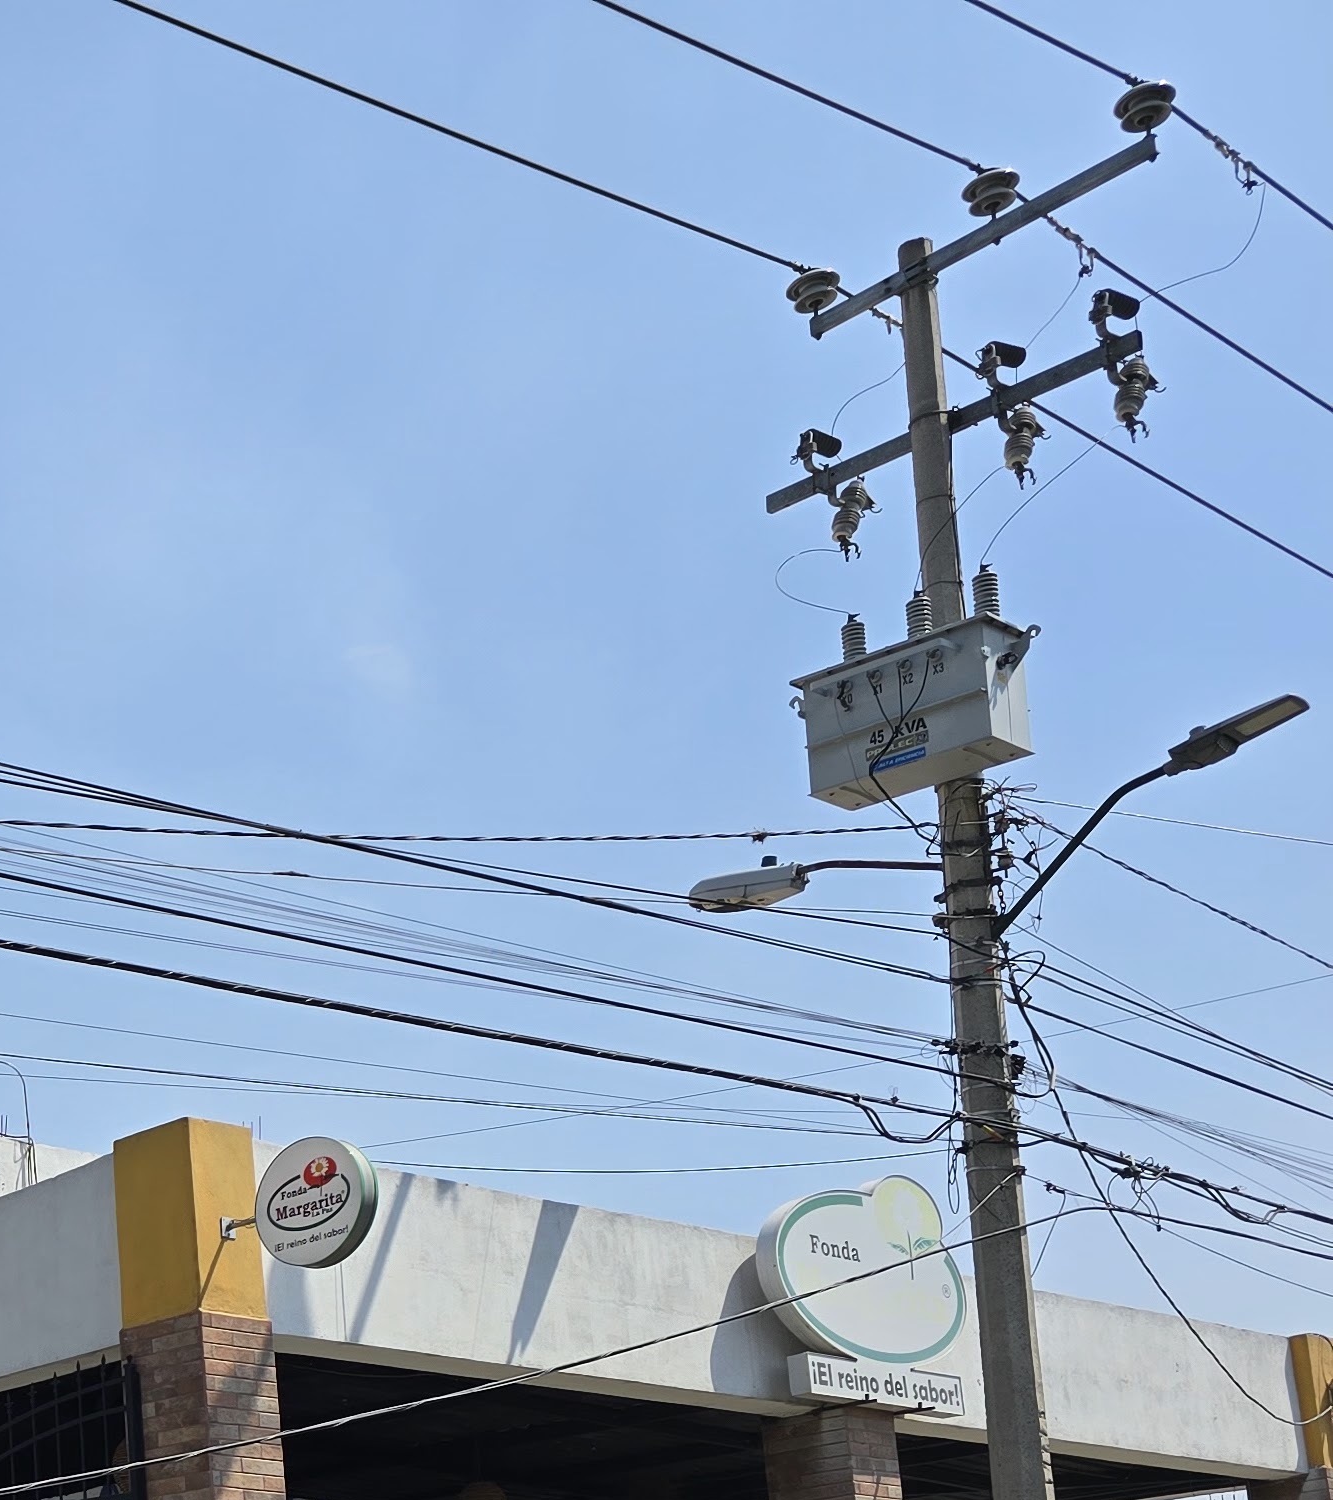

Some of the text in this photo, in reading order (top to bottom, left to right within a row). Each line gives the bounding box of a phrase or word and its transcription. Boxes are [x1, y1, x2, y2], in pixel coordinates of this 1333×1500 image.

[901, 672, 914, 686] X2
[932, 662, 945, 675] X3
[869, 729, 885, 745] 45
[280, 1186, 308, 1201] Fonda
[275, 1193, 345, 1222] Margarita
[286, 1238, 308, 1250] reino
[309, 1232, 322, 1243] del
[323, 1224, 349, 1239] sabor!
[809, 1233, 861, 1262] Fonda
[811, 1360, 961, 1407] ¡El reino del sabor!
